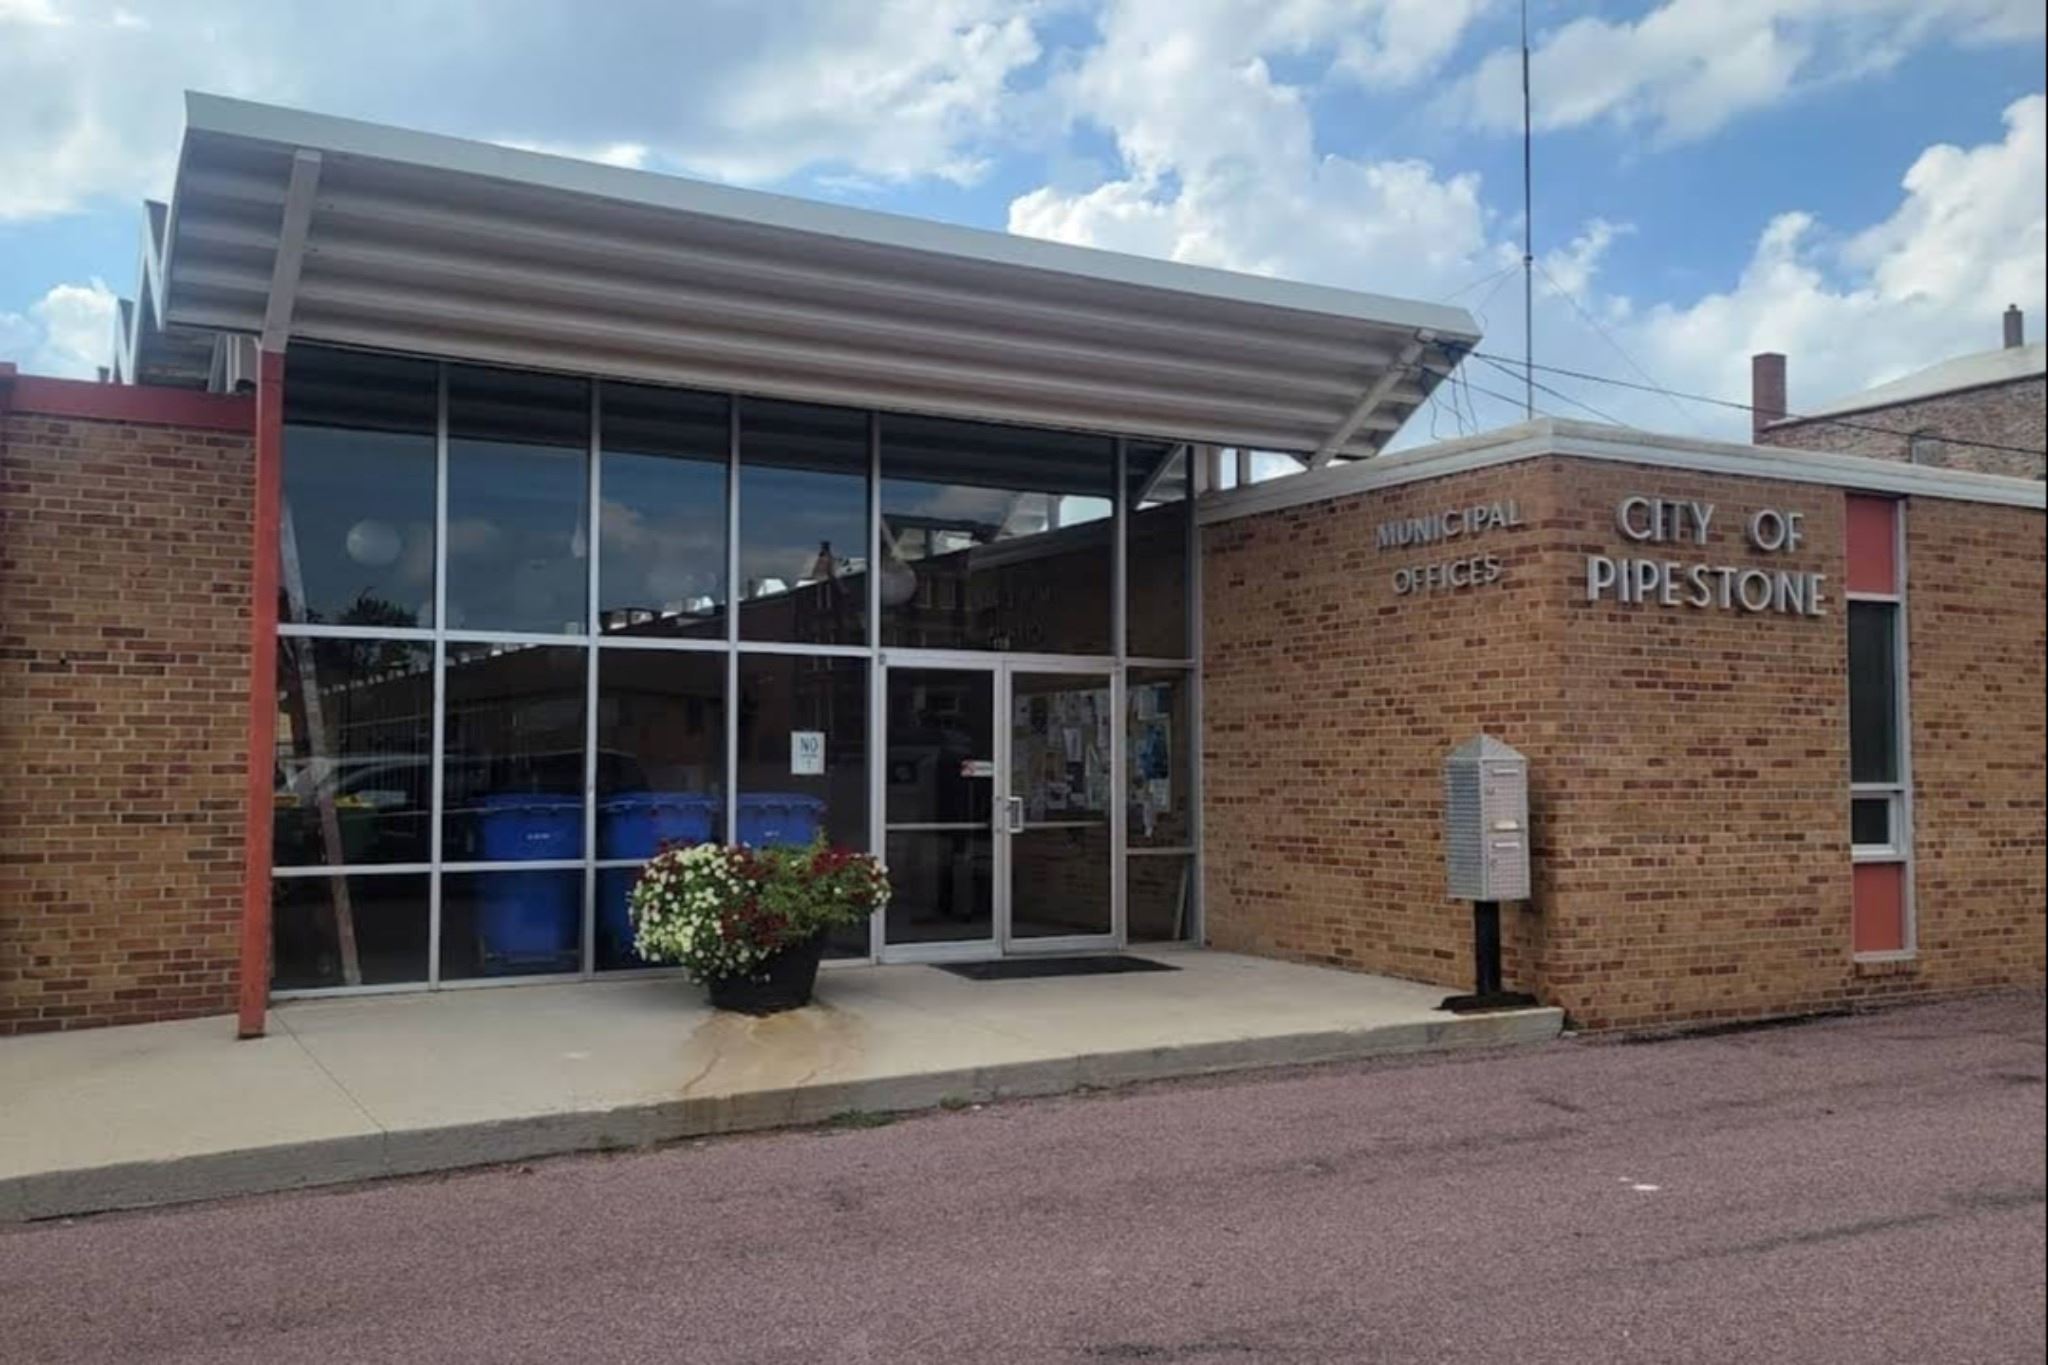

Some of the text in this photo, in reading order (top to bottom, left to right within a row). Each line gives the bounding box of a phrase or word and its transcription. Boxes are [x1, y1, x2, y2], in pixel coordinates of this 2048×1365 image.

[1376, 499, 1524, 548] MUNICIPAL
[1619, 497, 1804, 552] CITY OF
[1394, 555, 1501, 594] OFFICES
[1587, 556, 1827, 615] PIPESTONE
[800, 736, 819, 752] NO
